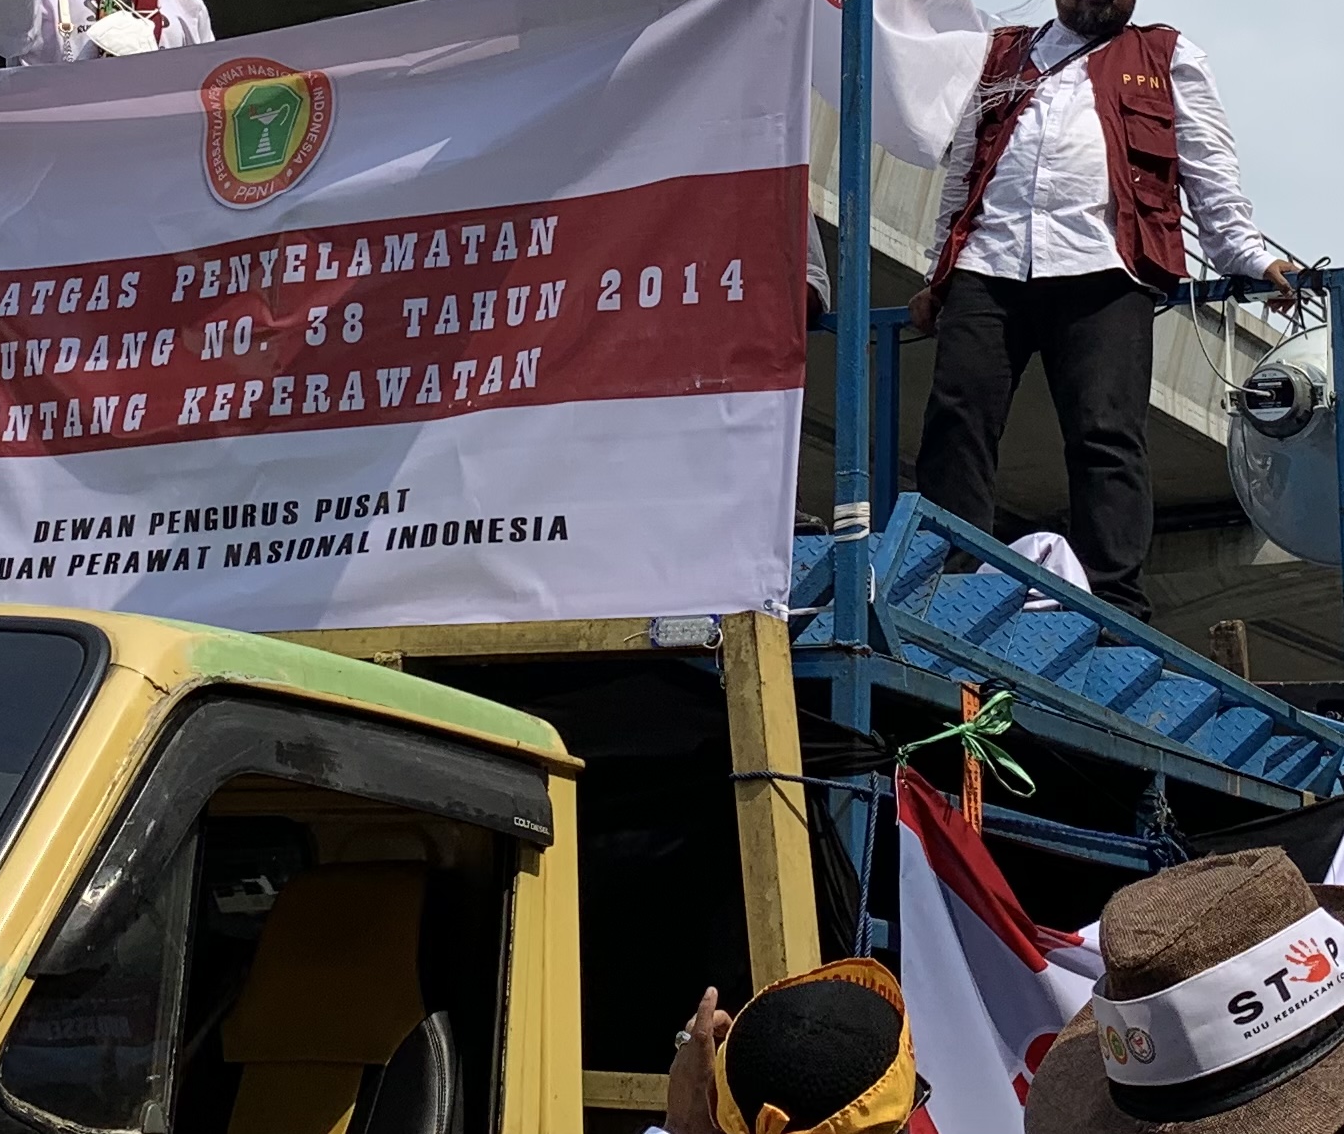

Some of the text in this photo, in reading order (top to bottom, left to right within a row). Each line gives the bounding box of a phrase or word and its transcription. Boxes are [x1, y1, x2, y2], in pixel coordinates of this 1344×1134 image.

[211, 101, 228, 181] PERSATUAN
[293, 87, 325, 164] INDONESIA
[234, 182, 275, 201] PPNI
[171, 216, 559, 303] PENYELAMATAN
[201, 316, 268, 361] NO.
[306, 303, 364, 347] 38
[403, 280, 566, 338] TAHUN
[597, 259, 744, 311] 2014
[177, 347, 541, 426] KEPERAWATAN
[33, 488, 410, 543] DEWAN PENGURUS PUSAT
[67, 545, 211, 576] PERAWAT
[223, 531, 370, 568] NASIONAL
[386, 516, 568, 551] INDONESIA
[1244, 1021, 1269, 1040] RUU
[1273, 980, 1334, 1024] KESEHATAN
